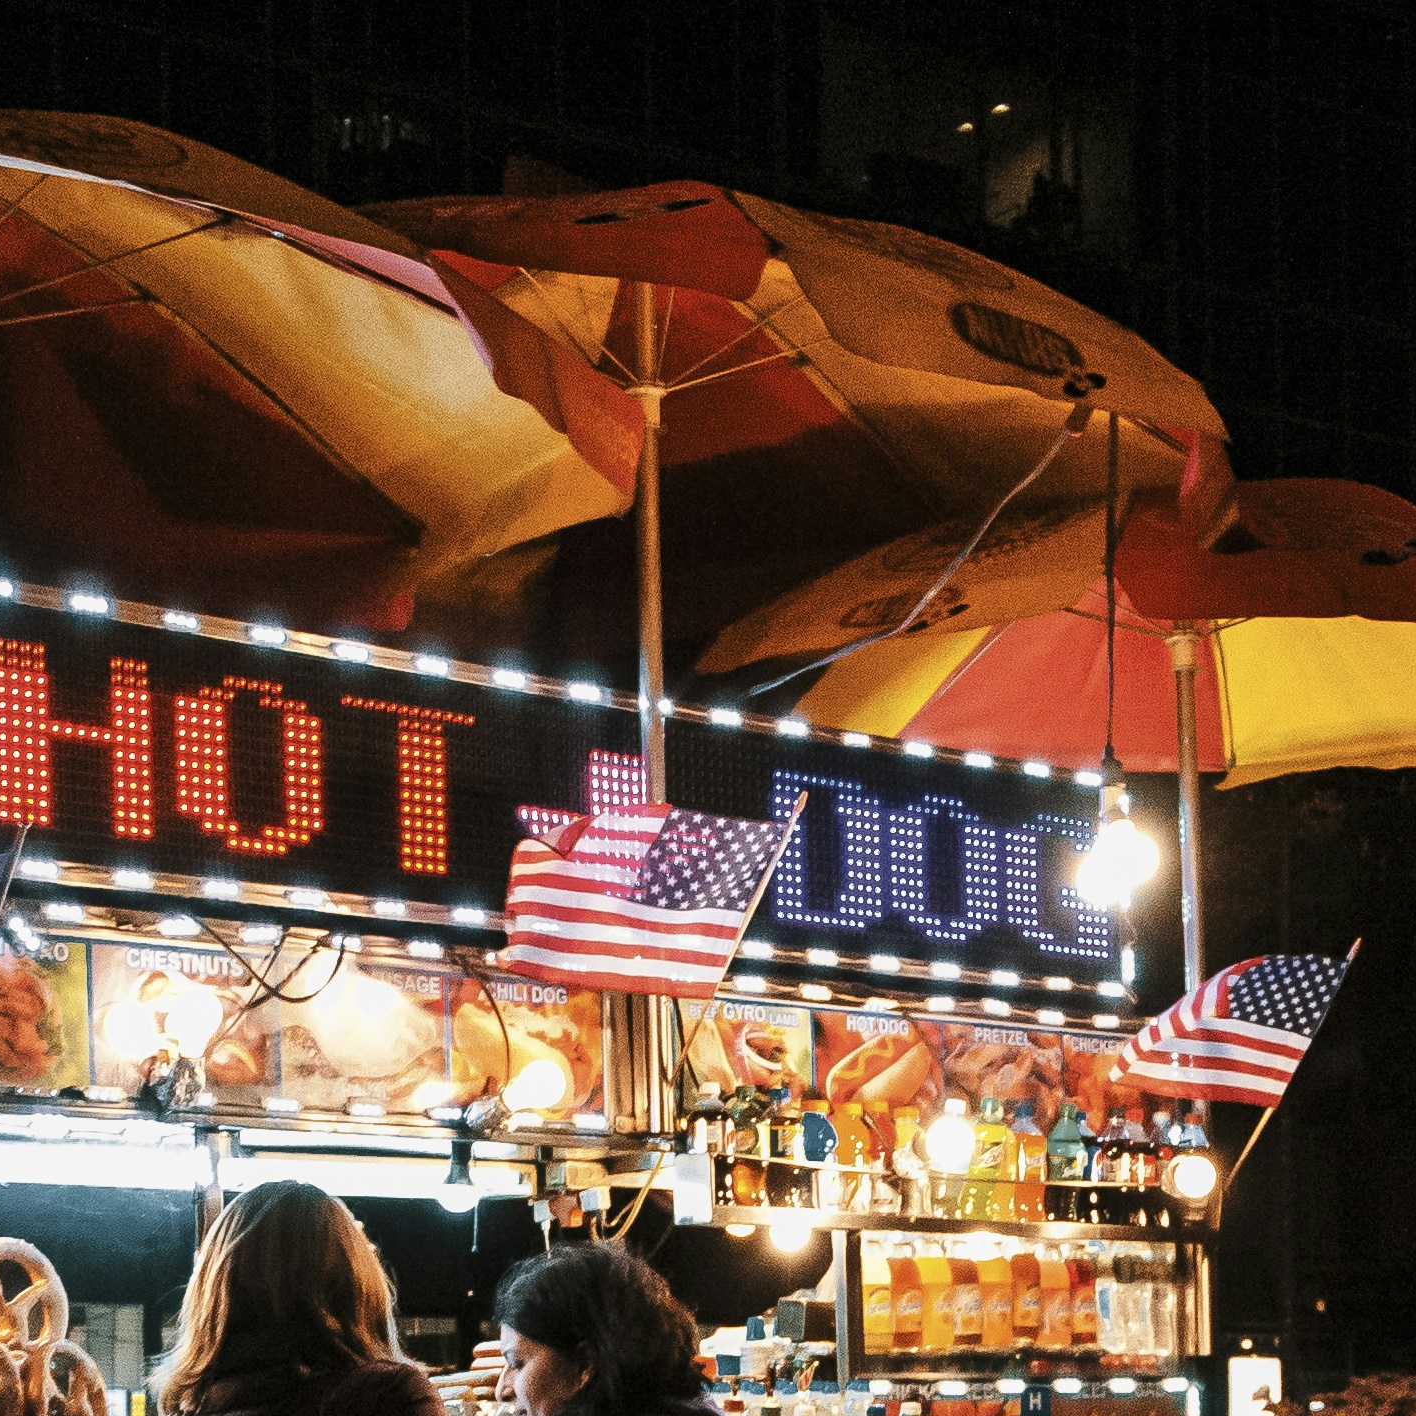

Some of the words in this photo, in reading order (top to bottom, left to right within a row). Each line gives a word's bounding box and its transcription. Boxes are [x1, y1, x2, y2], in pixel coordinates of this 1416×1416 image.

[772, 767, 1110, 960] DOG
[126, 949, 245, 978] CHESTNUTS
[531, 985, 568, 1005] DOG
[723, 1003, 766, 1022] GYRO
[769, 1012, 800, 1028] LAMB
[846, 1015, 873, 1033] HOT
[878, 1017, 909, 1037] DOG
[973, 1026, 1030, 1047] PRETZEL
